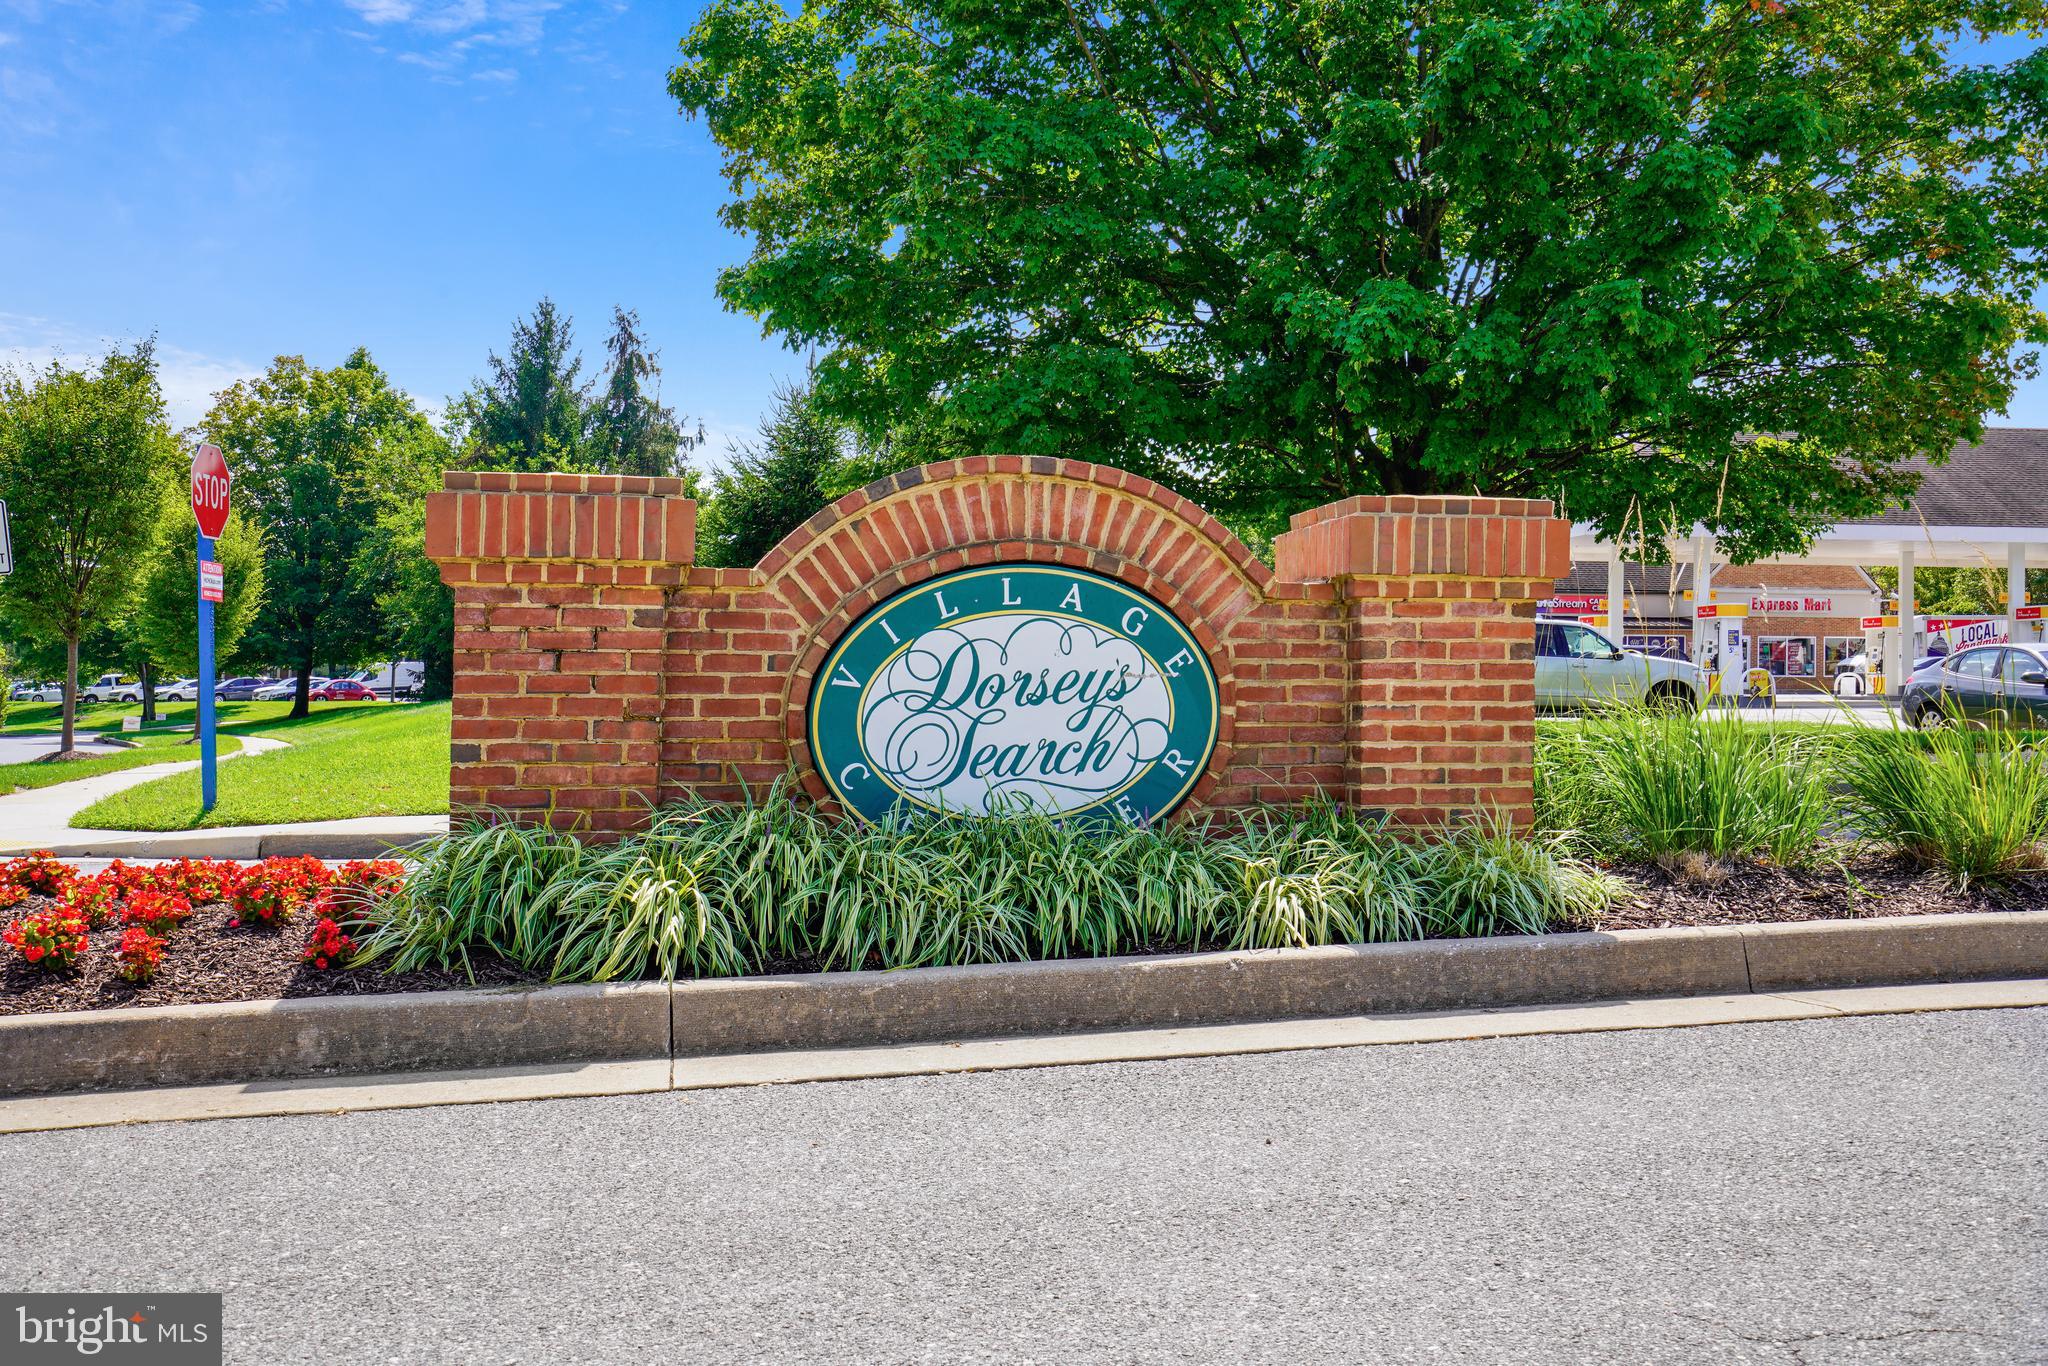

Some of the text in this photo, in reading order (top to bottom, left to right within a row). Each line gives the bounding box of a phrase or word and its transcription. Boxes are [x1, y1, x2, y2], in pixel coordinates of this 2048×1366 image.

[194, 473, 228, 510] STOP
[1536, 597, 1588, 608] utoStream
[1752, 597, 1832, 612] Express Mart
[1961, 622, 1999, 643] LOCAL
[831, 577, 1194, 689] VILLAGE
[903, 629, 1131, 732] Dorsey's
[893, 704, 1131, 790] Search
[840, 748, 1194, 832] CER
